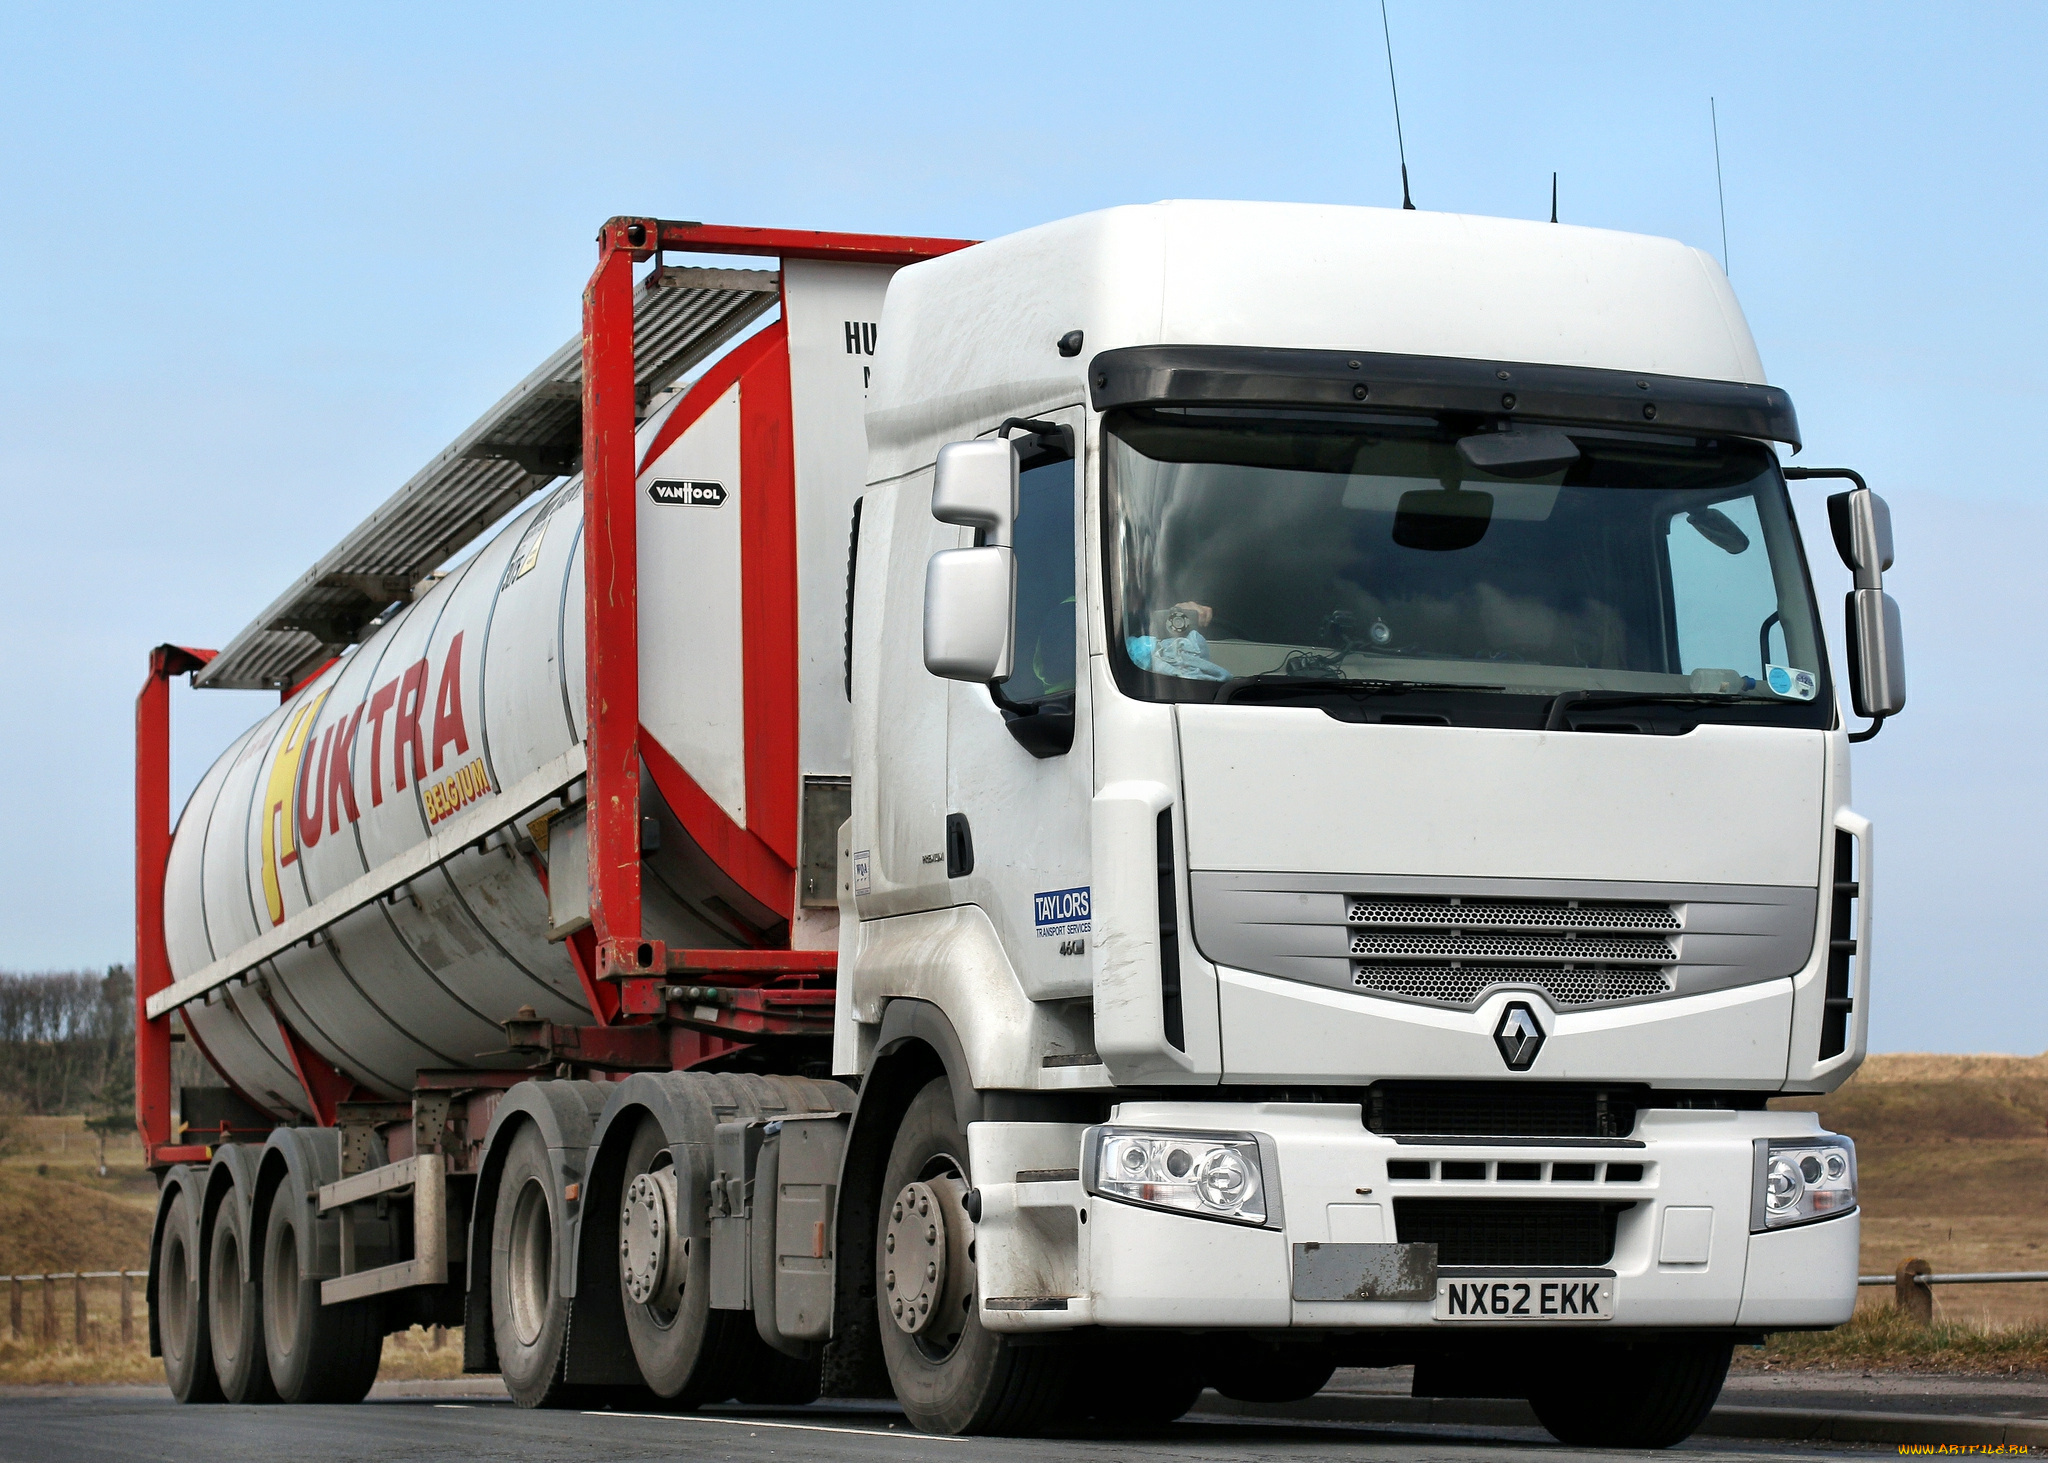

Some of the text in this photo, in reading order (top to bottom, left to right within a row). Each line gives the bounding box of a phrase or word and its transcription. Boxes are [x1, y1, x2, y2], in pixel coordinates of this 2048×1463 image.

[261, 629, 470, 927] HUKTRA
[423, 757, 492, 825] BELGIUM
[1036, 891, 1089, 921] TAYLORS
[1036, 922, 1091, 938] TRANSPORT SERVICES
[1449, 1283, 1600, 1315] NX62 EKK
